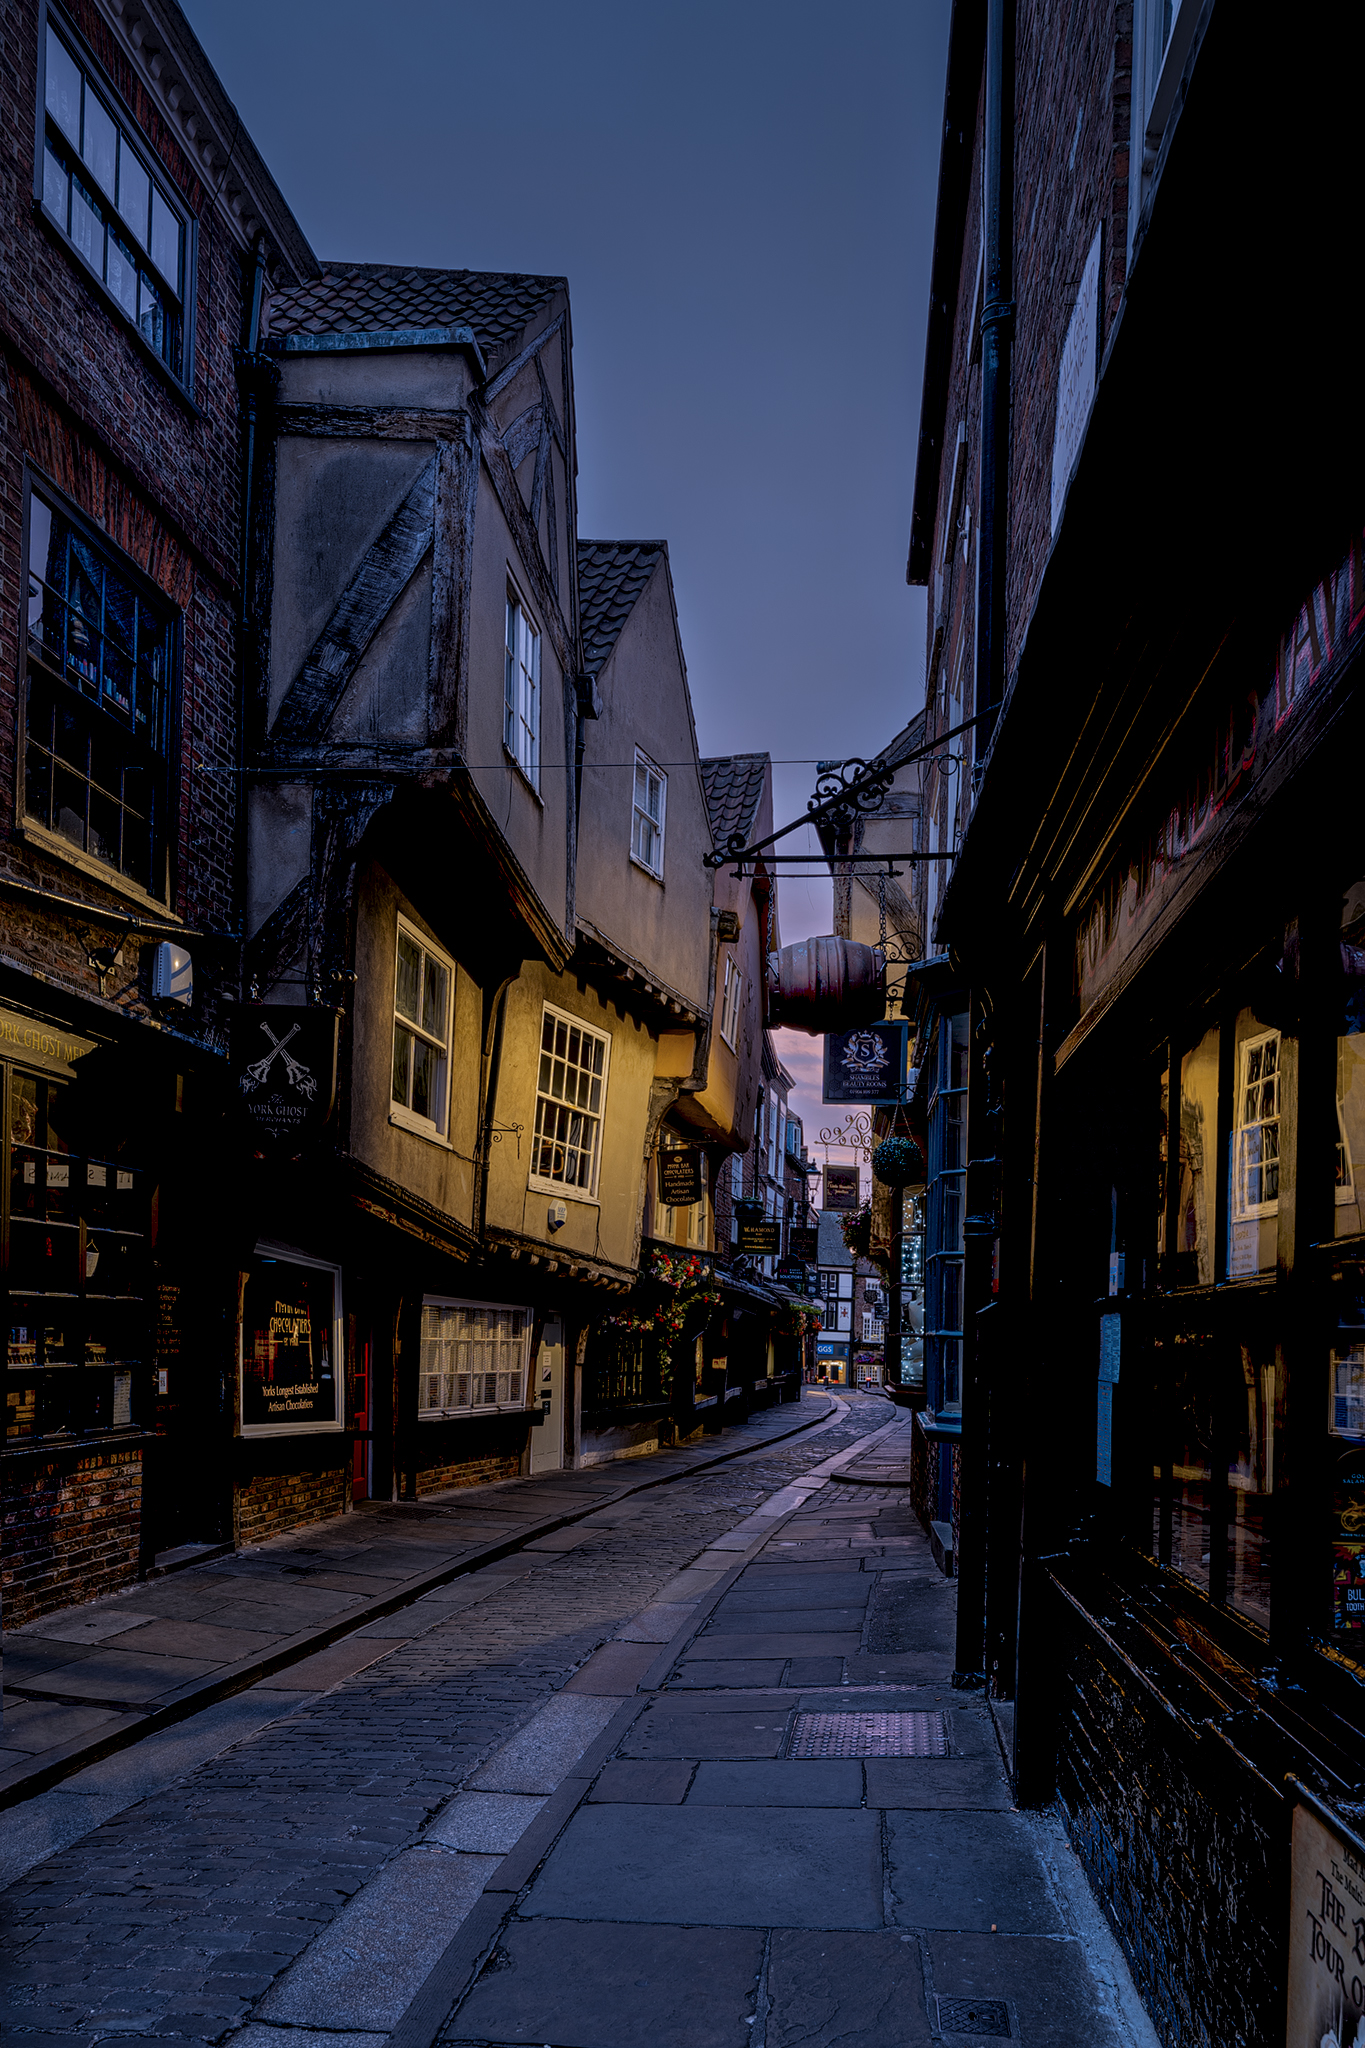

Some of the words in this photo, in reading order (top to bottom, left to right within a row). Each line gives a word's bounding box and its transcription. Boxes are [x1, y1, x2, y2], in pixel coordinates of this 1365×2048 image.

[24, 1030, 61, 1057] GHOST
[861, 1044, 870, 1057] S
[248, 1103, 273, 1114] YORK
[276, 1105, 308, 1117] GHOST
[269, 1316, 312, 1334] CHOCOLATIERS
[276, 1385, 295, 1399] Longest
[294, 1382, 319, 1395] Established
[267, 1401, 286, 1413] Artisan
[285, 1398, 314, 1411] Chocolatiers
[1330, 1859, 1344, 1885] The
[1316, 1869, 1347, 1937] THE
[1307, 1908, 1349, 1999] TOUR
